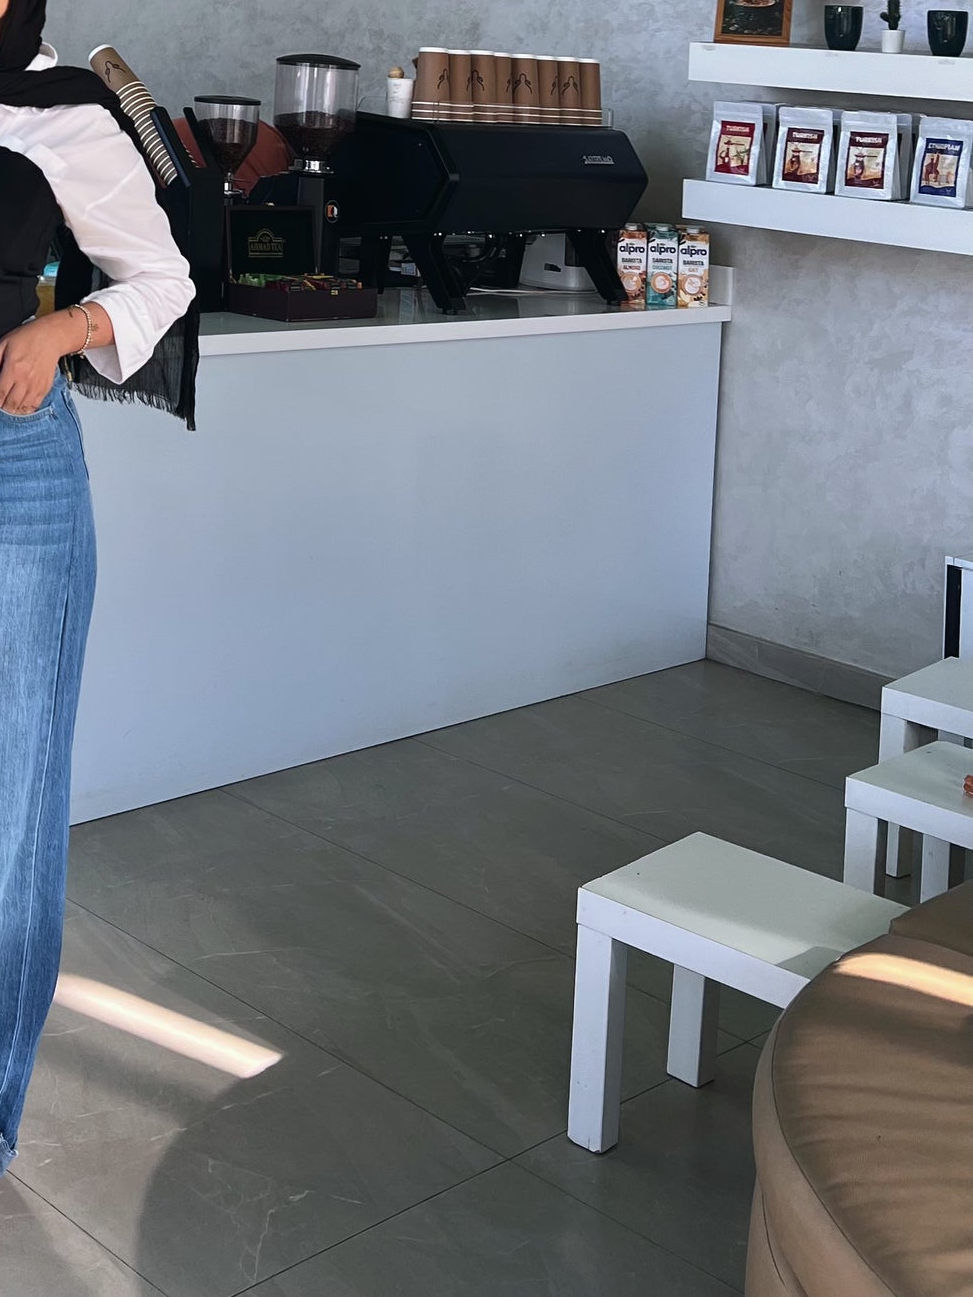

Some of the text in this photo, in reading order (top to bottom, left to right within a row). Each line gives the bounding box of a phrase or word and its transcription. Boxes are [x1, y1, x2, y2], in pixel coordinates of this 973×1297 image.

[619, 243, 645, 255] alpro
[650, 243, 676, 255] alpro
[680, 245, 707, 258] alpro
